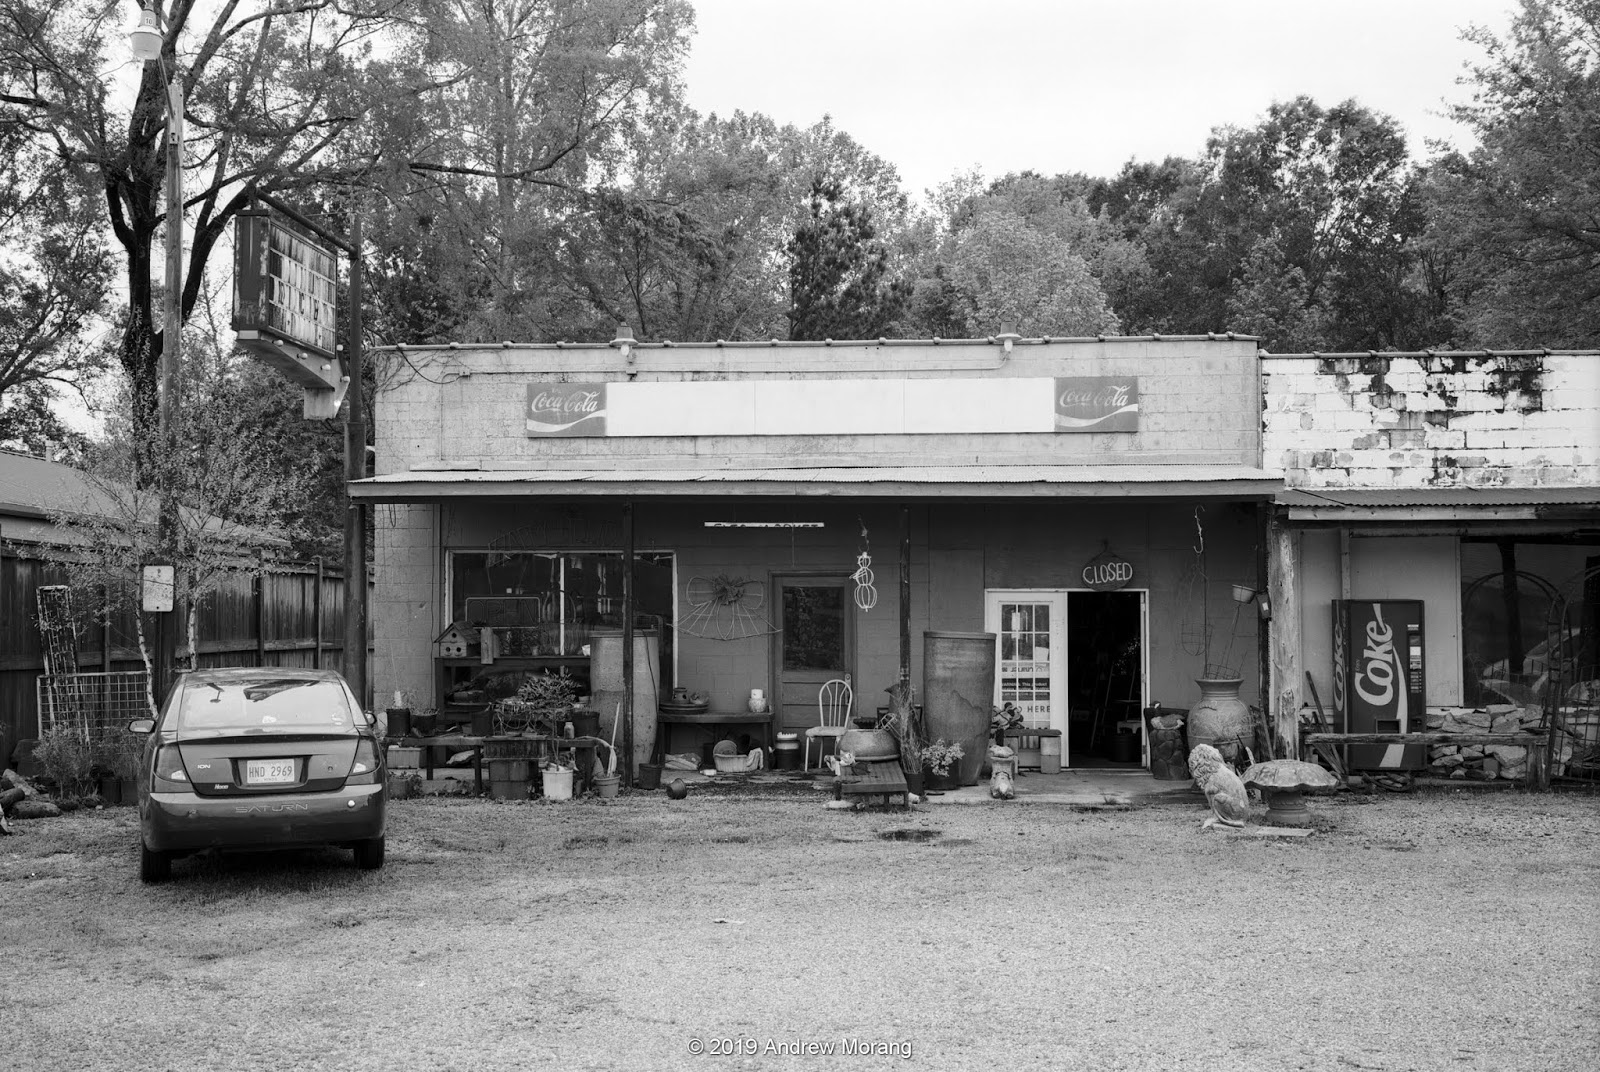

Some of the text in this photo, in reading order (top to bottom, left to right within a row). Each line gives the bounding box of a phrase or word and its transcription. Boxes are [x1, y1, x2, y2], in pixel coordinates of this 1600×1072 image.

[1083, 562, 1133, 584] CLOSED
[1333, 600, 1344, 711] Coke
[1355, 604, 1393, 706] Coke
[1027, 705, 1050, 713] HERE
[271, 766, 292, 777] 2969
[235, 804, 307, 813] SATURN
